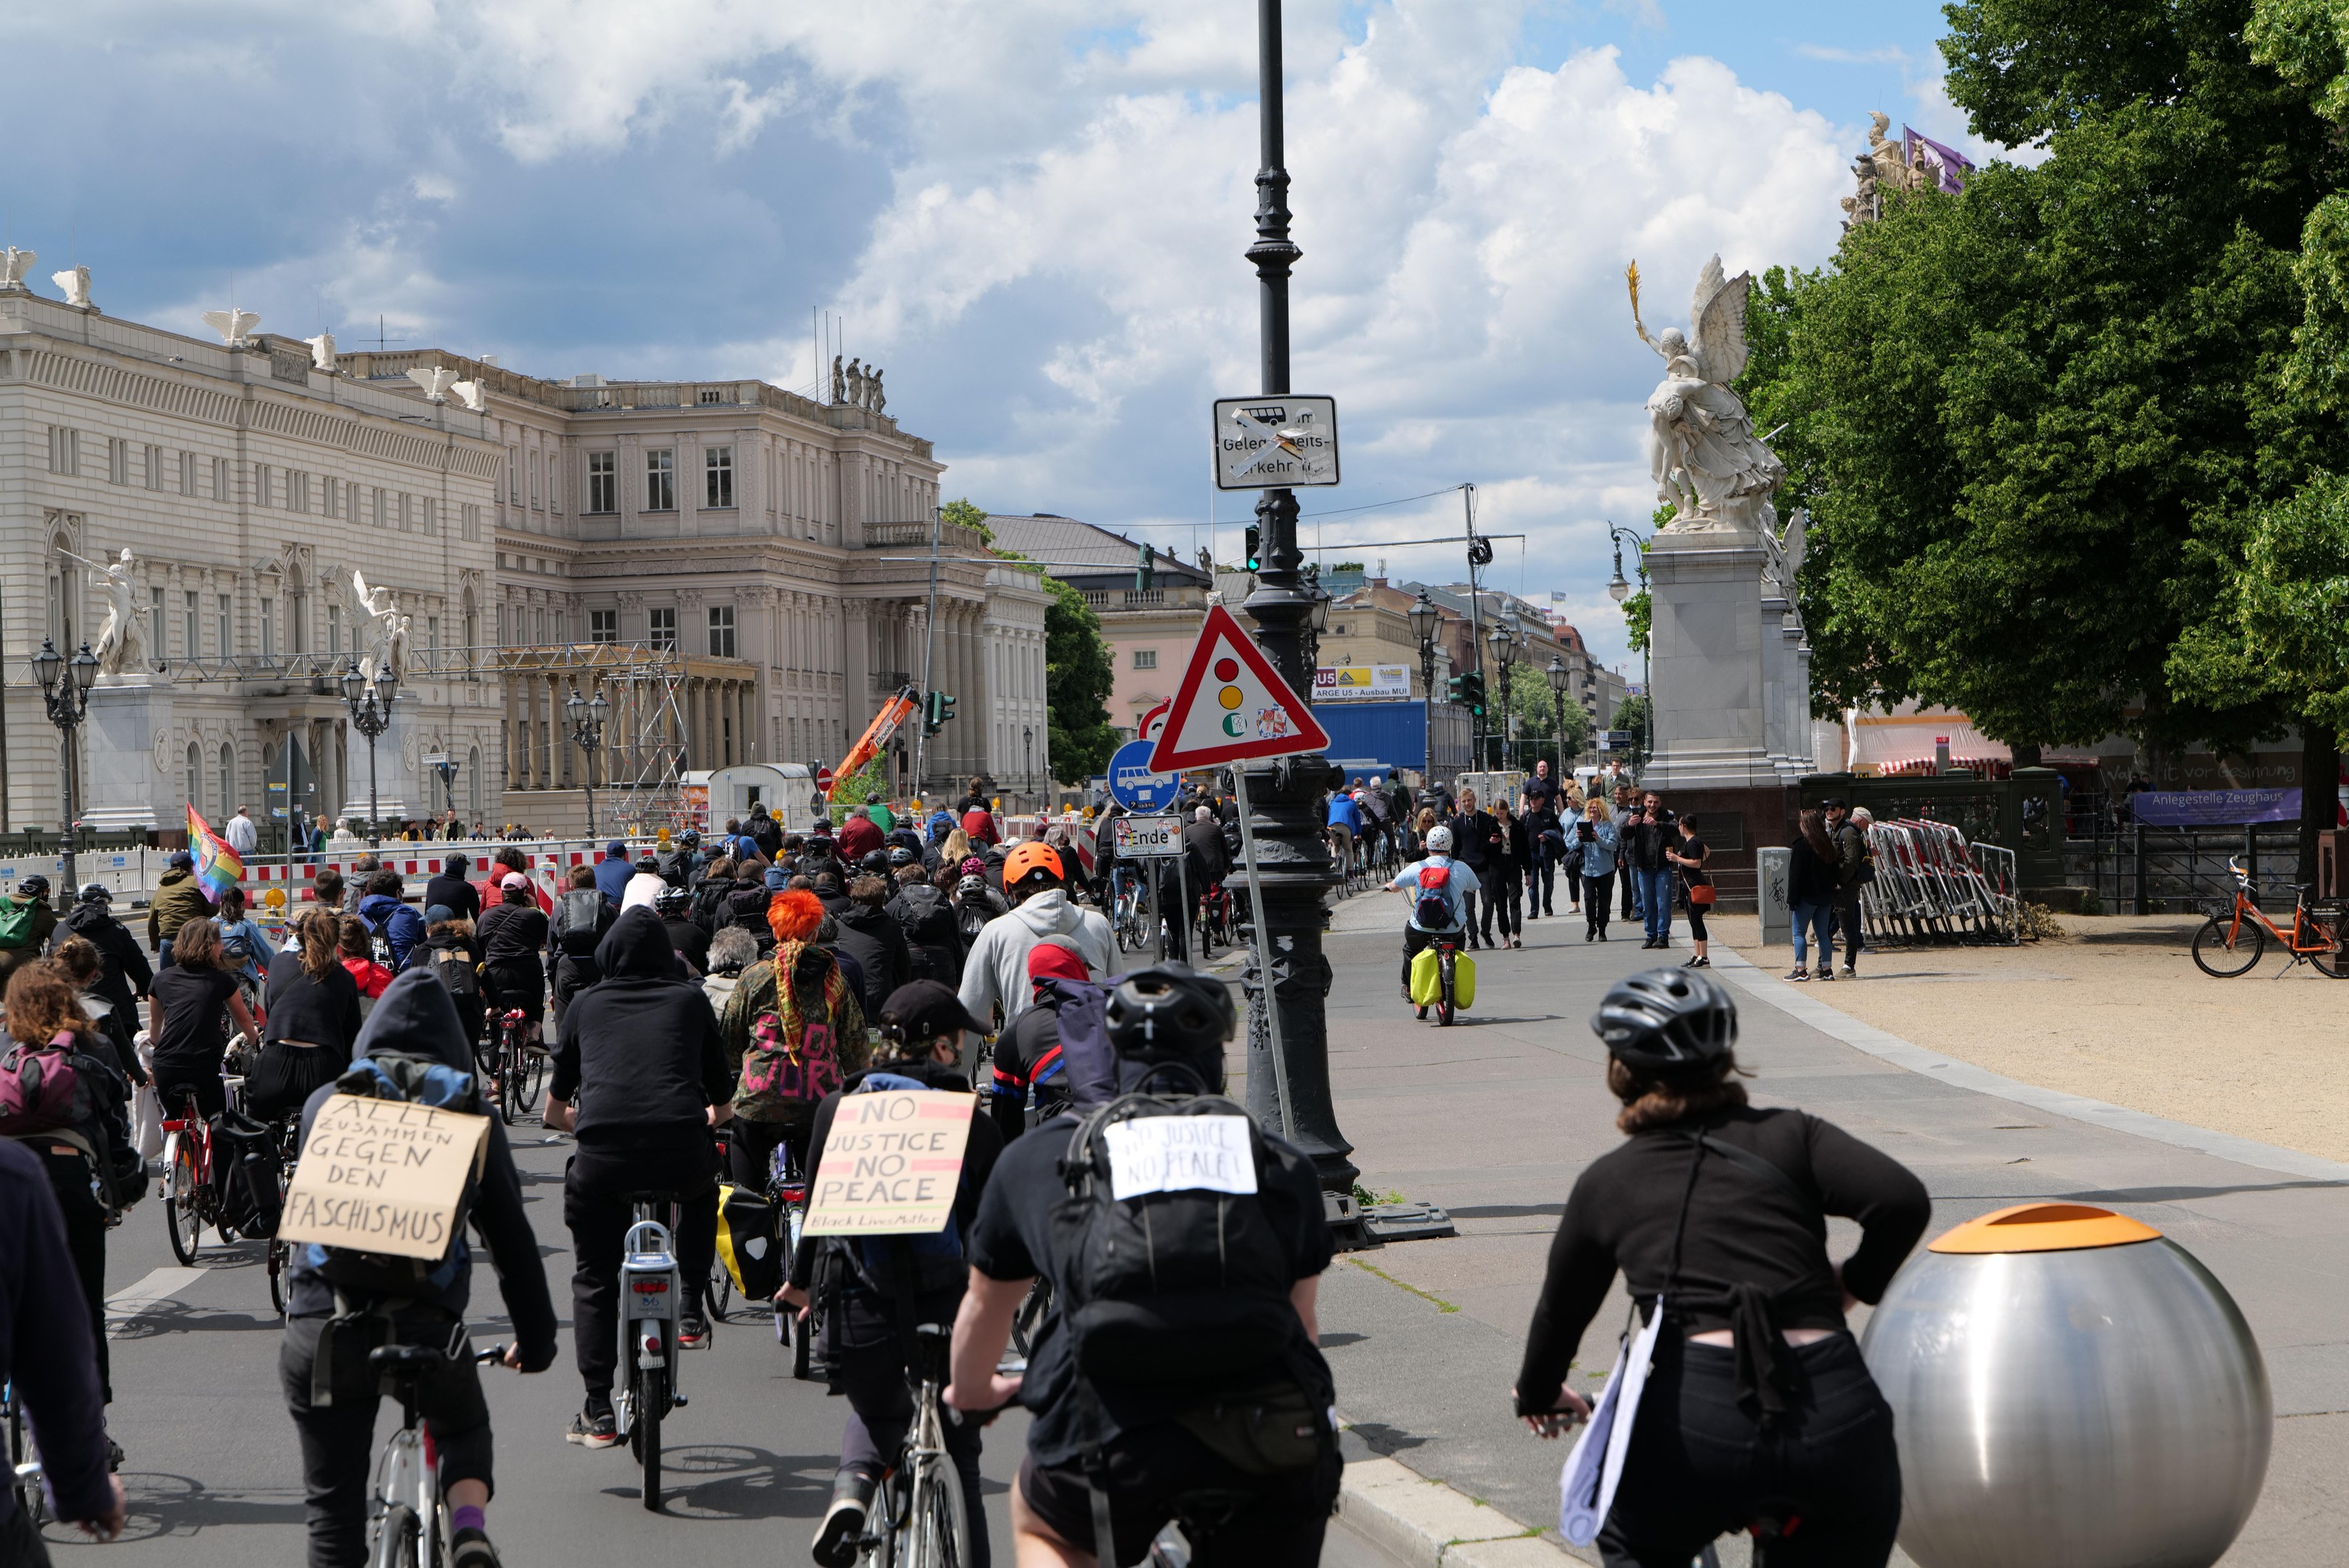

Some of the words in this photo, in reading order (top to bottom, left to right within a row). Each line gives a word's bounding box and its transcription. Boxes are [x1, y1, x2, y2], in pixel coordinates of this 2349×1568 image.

[1318, 672, 1335, 685] U5
[875, 722, 894, 746] Boels
[2152, 792, 2223, 807] Anlegestelle
[2226, 791, 2284, 804] Zeughaus
[1132, 828, 1168, 845] Ende
[332, 1099, 445, 1130] ALLE
[859, 1097, 915, 1124] NO
[318, 1117, 453, 1145] ZUSAMMEN
[826, 1132, 948, 1152] JUSTICE
[1162, 1122, 1233, 1150] JUSTICE
[310, 1134, 432, 1167] GEGEN
[327, 1164, 387, 1188] DEN
[854, 1154, 905, 1177] NO
[1128, 1156, 1156, 1185] NO
[819, 1177, 936, 1207] PEACE
[811, 1214, 853, 1228] Black
